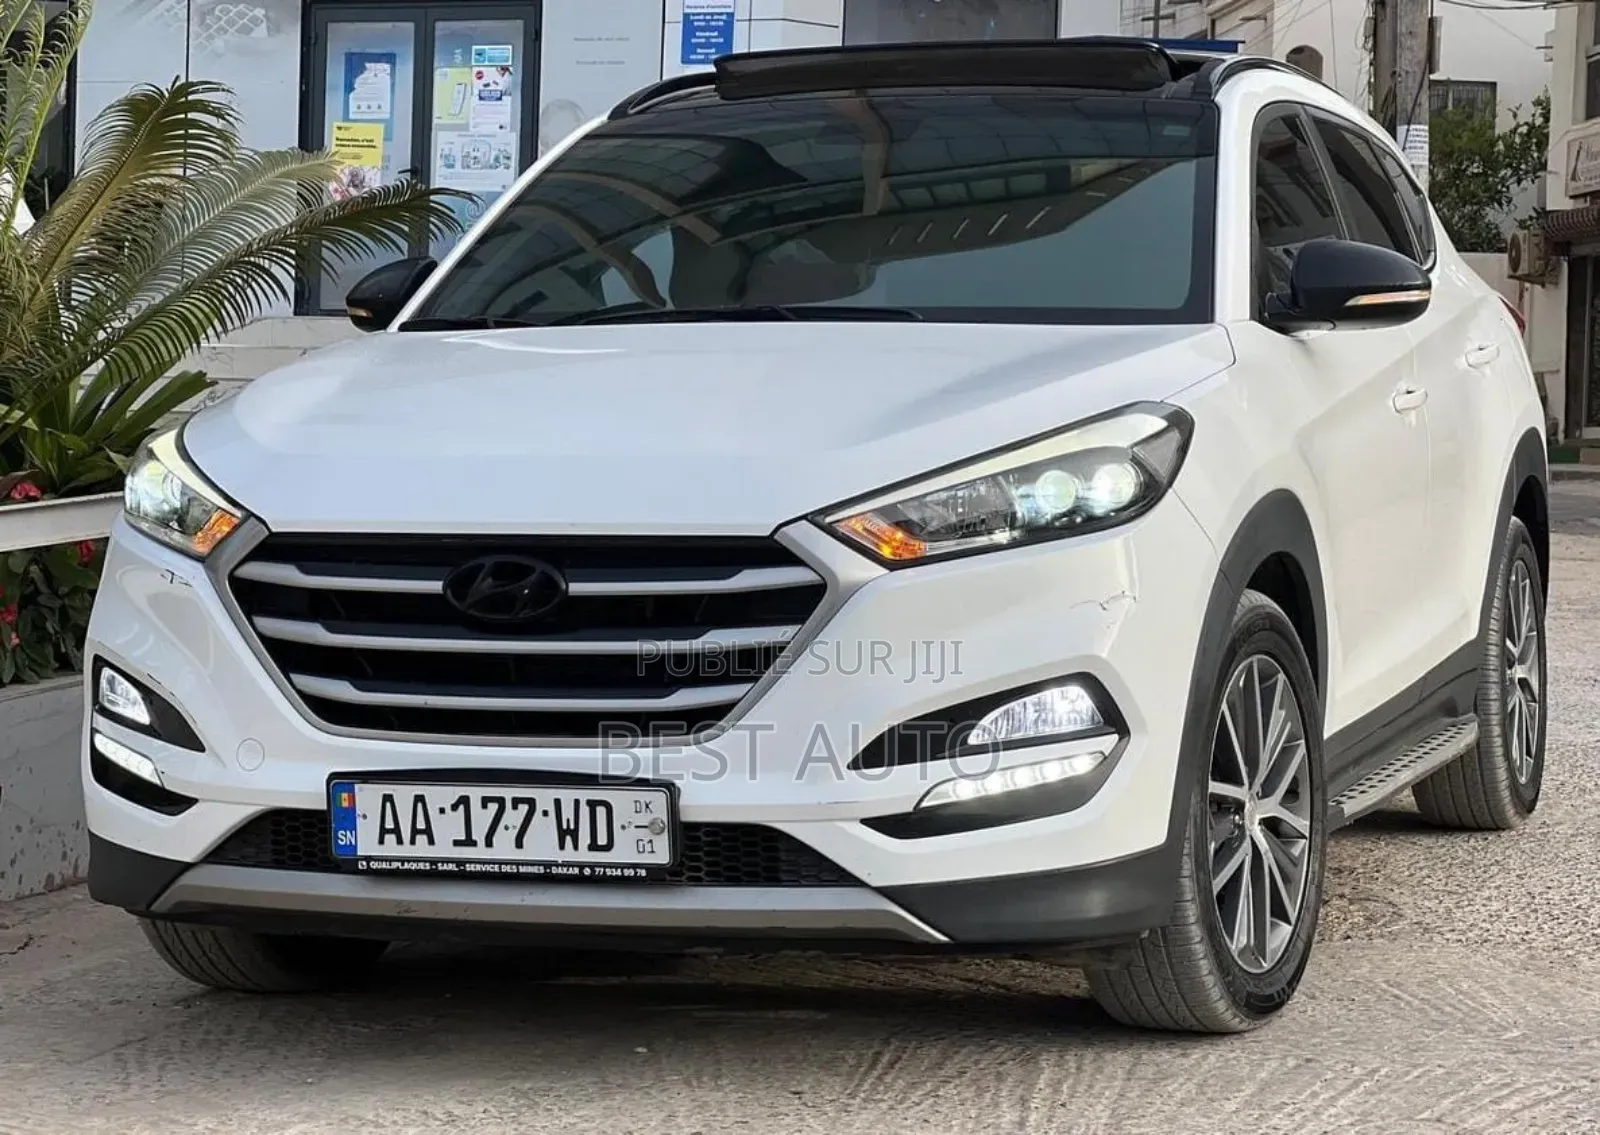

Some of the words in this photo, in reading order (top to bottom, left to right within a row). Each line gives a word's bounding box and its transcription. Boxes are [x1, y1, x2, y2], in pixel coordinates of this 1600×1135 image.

[633, 799, 653, 814] DK
[337, 830, 356, 846] SN
[437, 863, 459, 871] SARL
[465, 864, 499, 872] SERVICE
[501, 865, 517, 873] DES
[551, 866, 580, 875] DAKAR
